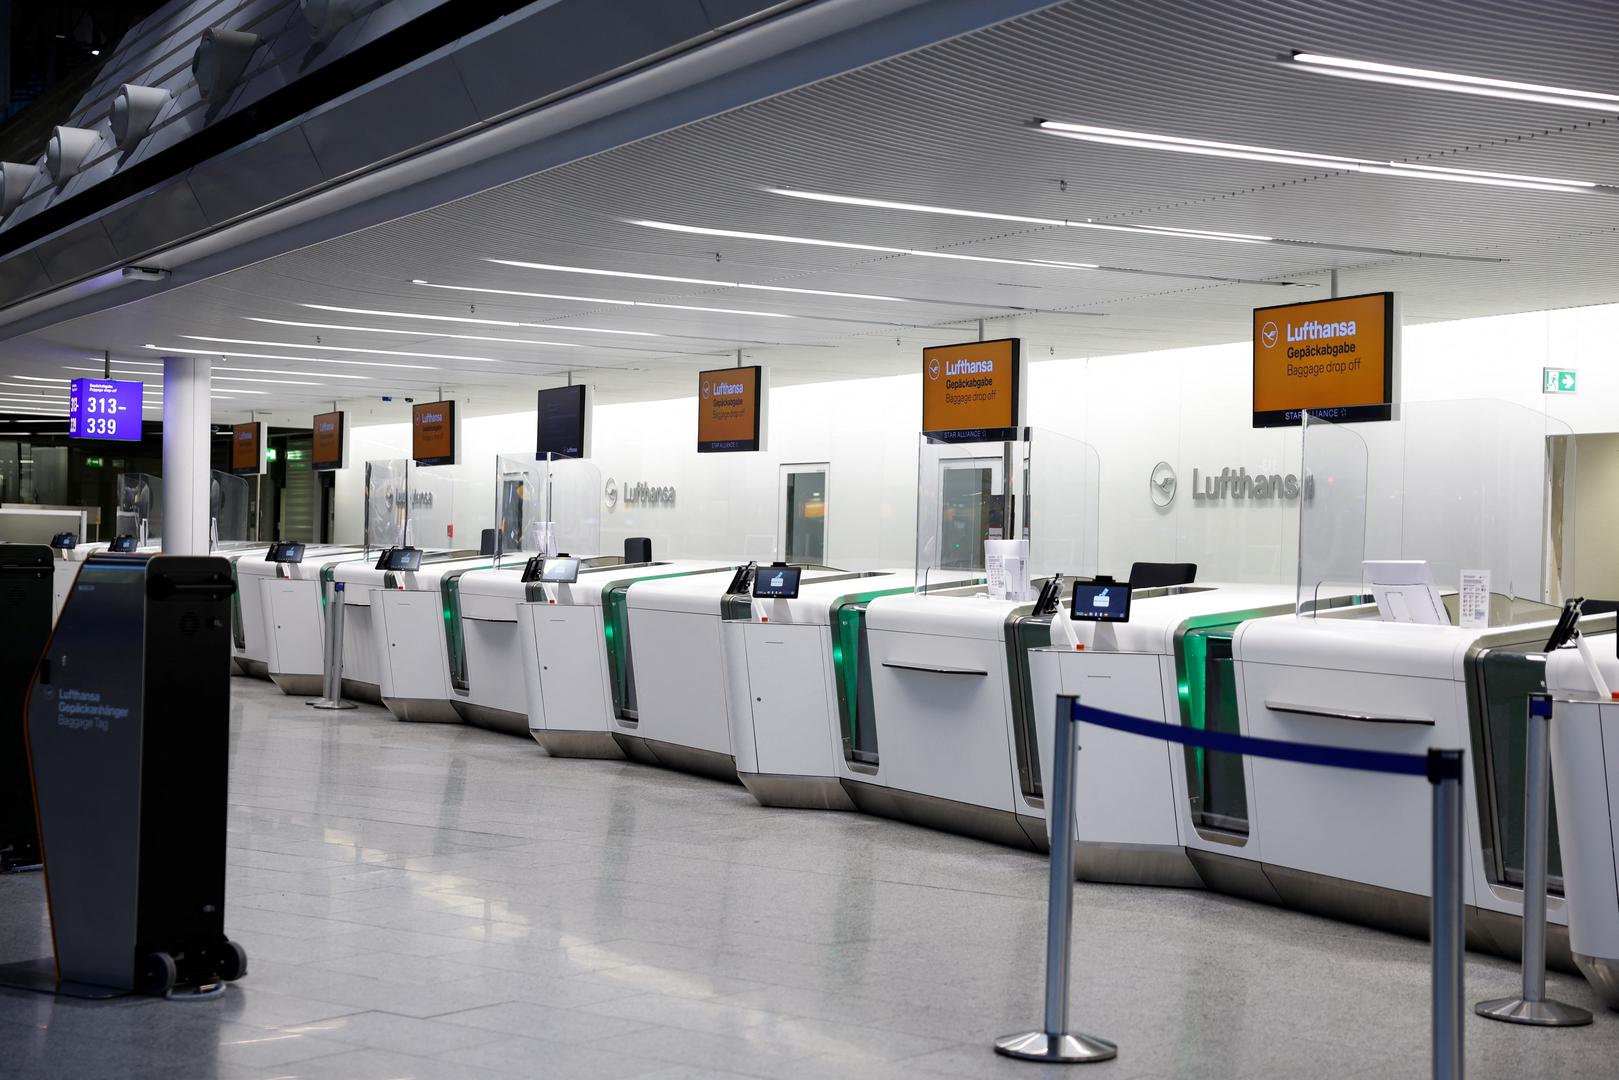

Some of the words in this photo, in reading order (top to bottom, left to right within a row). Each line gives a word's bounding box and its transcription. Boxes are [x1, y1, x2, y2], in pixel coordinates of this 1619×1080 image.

[1287, 320, 1357, 342] Lufthansa
[1287, 342, 1356, 360] Gepäckabgabe
[946, 359, 993, 376] Lufthansa
[1287, 362, 1325, 378] Baggage
[1326, 361, 1347, 375] drop
[1348, 358, 1361, 371] off
[713, 382, 744, 396] Lufthansa
[946, 377, 993, 391] Gepäckabgabe
[87, 396, 127, 415] 313-
[86, 417, 117, 435] 339
[623, 481, 676, 504] Lufthansa
[59, 688, 101, 702] Lufthansa
